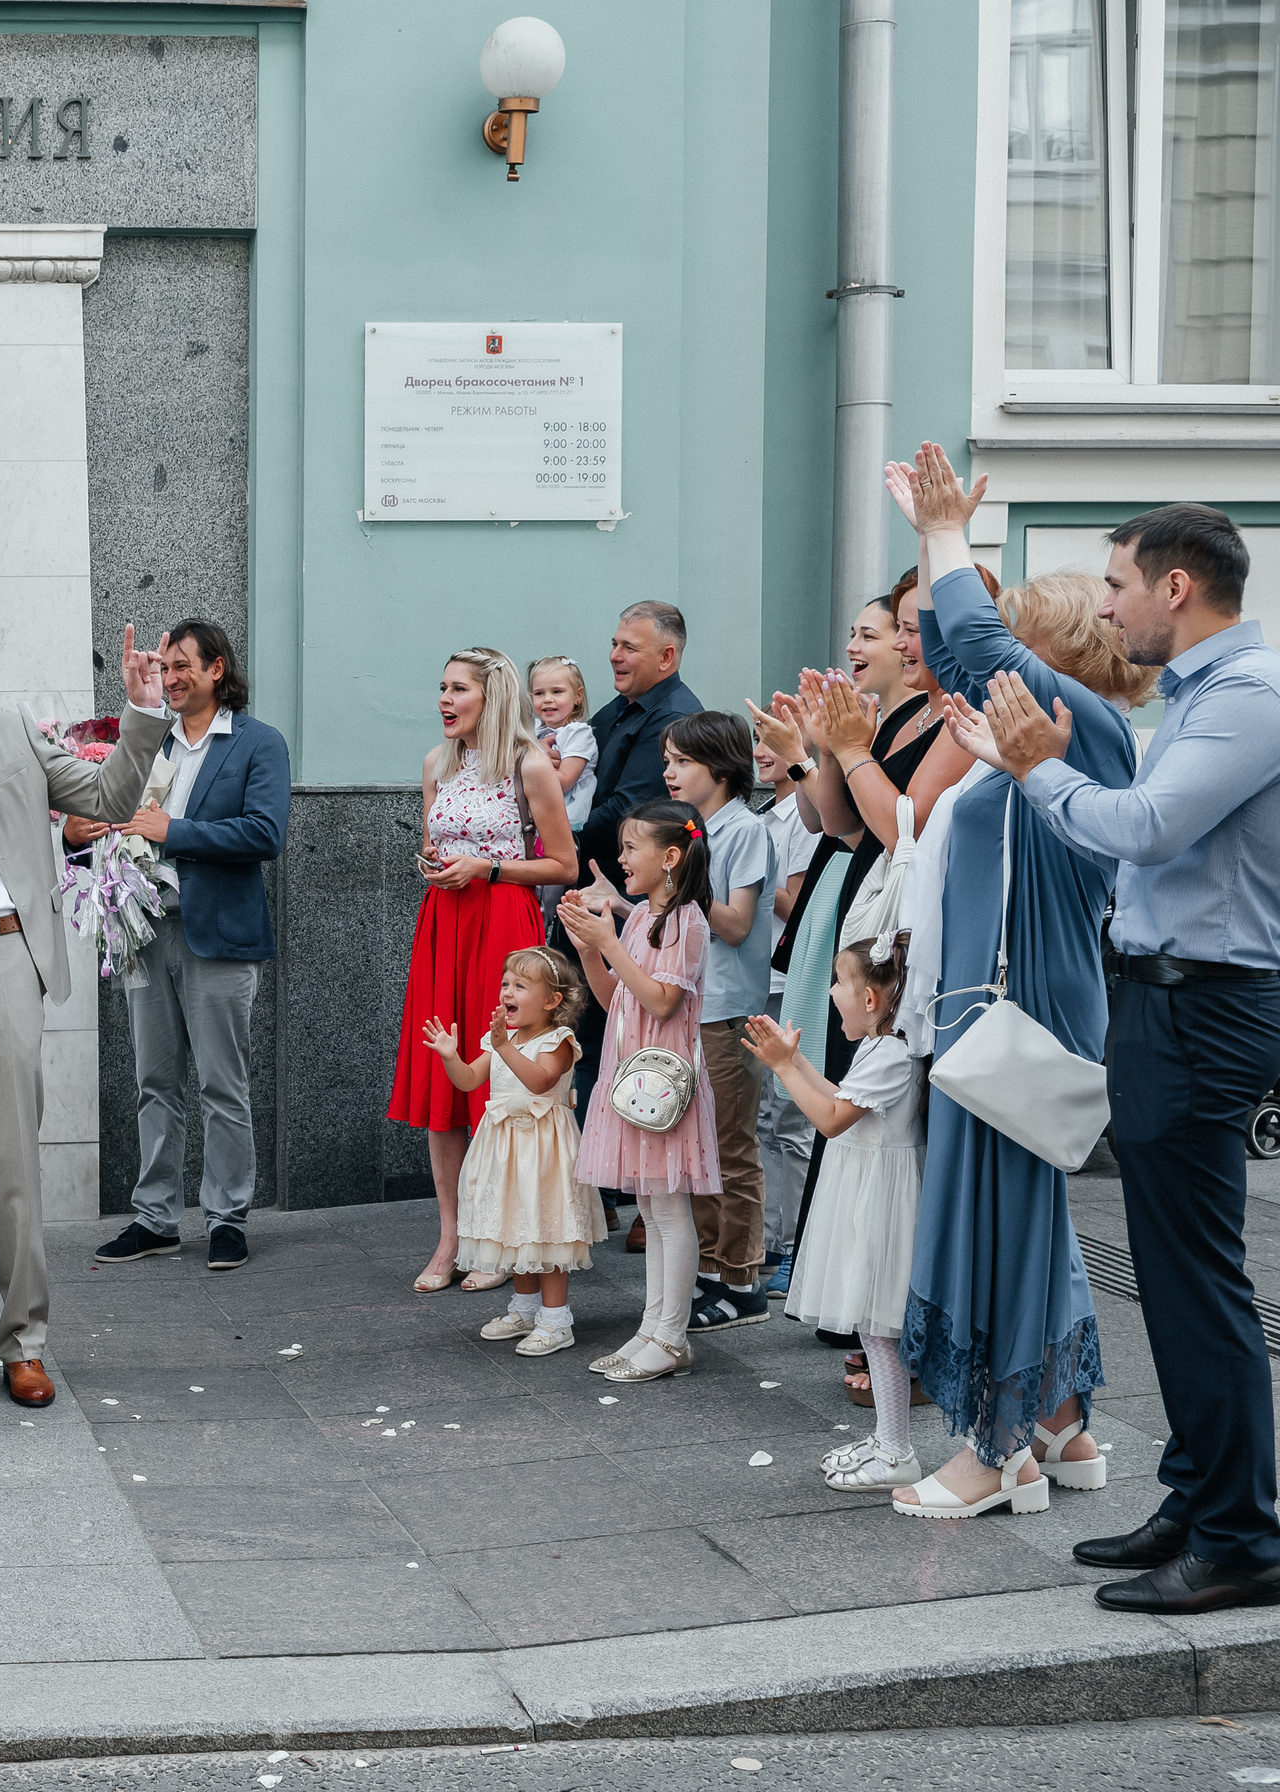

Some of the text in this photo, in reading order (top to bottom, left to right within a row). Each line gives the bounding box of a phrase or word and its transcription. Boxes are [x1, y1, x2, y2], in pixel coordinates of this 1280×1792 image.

[404, 375, 584, 389] Дворец бракосочетания № 1
[451, 406, 537, 416] РЕЖИМ РАБОТЫ
[543, 422, 567, 432] 9:00
[578, 422, 607, 432] 18:00
[543, 439, 567, 449] 9:00
[576, 439, 607, 449] 20:00
[543, 456, 567, 466] 9:00
[576, 456, 607, 466] 23:59
[535, 473, 567, 483] 00:00
[577, 473, 607, 483] 19:00
